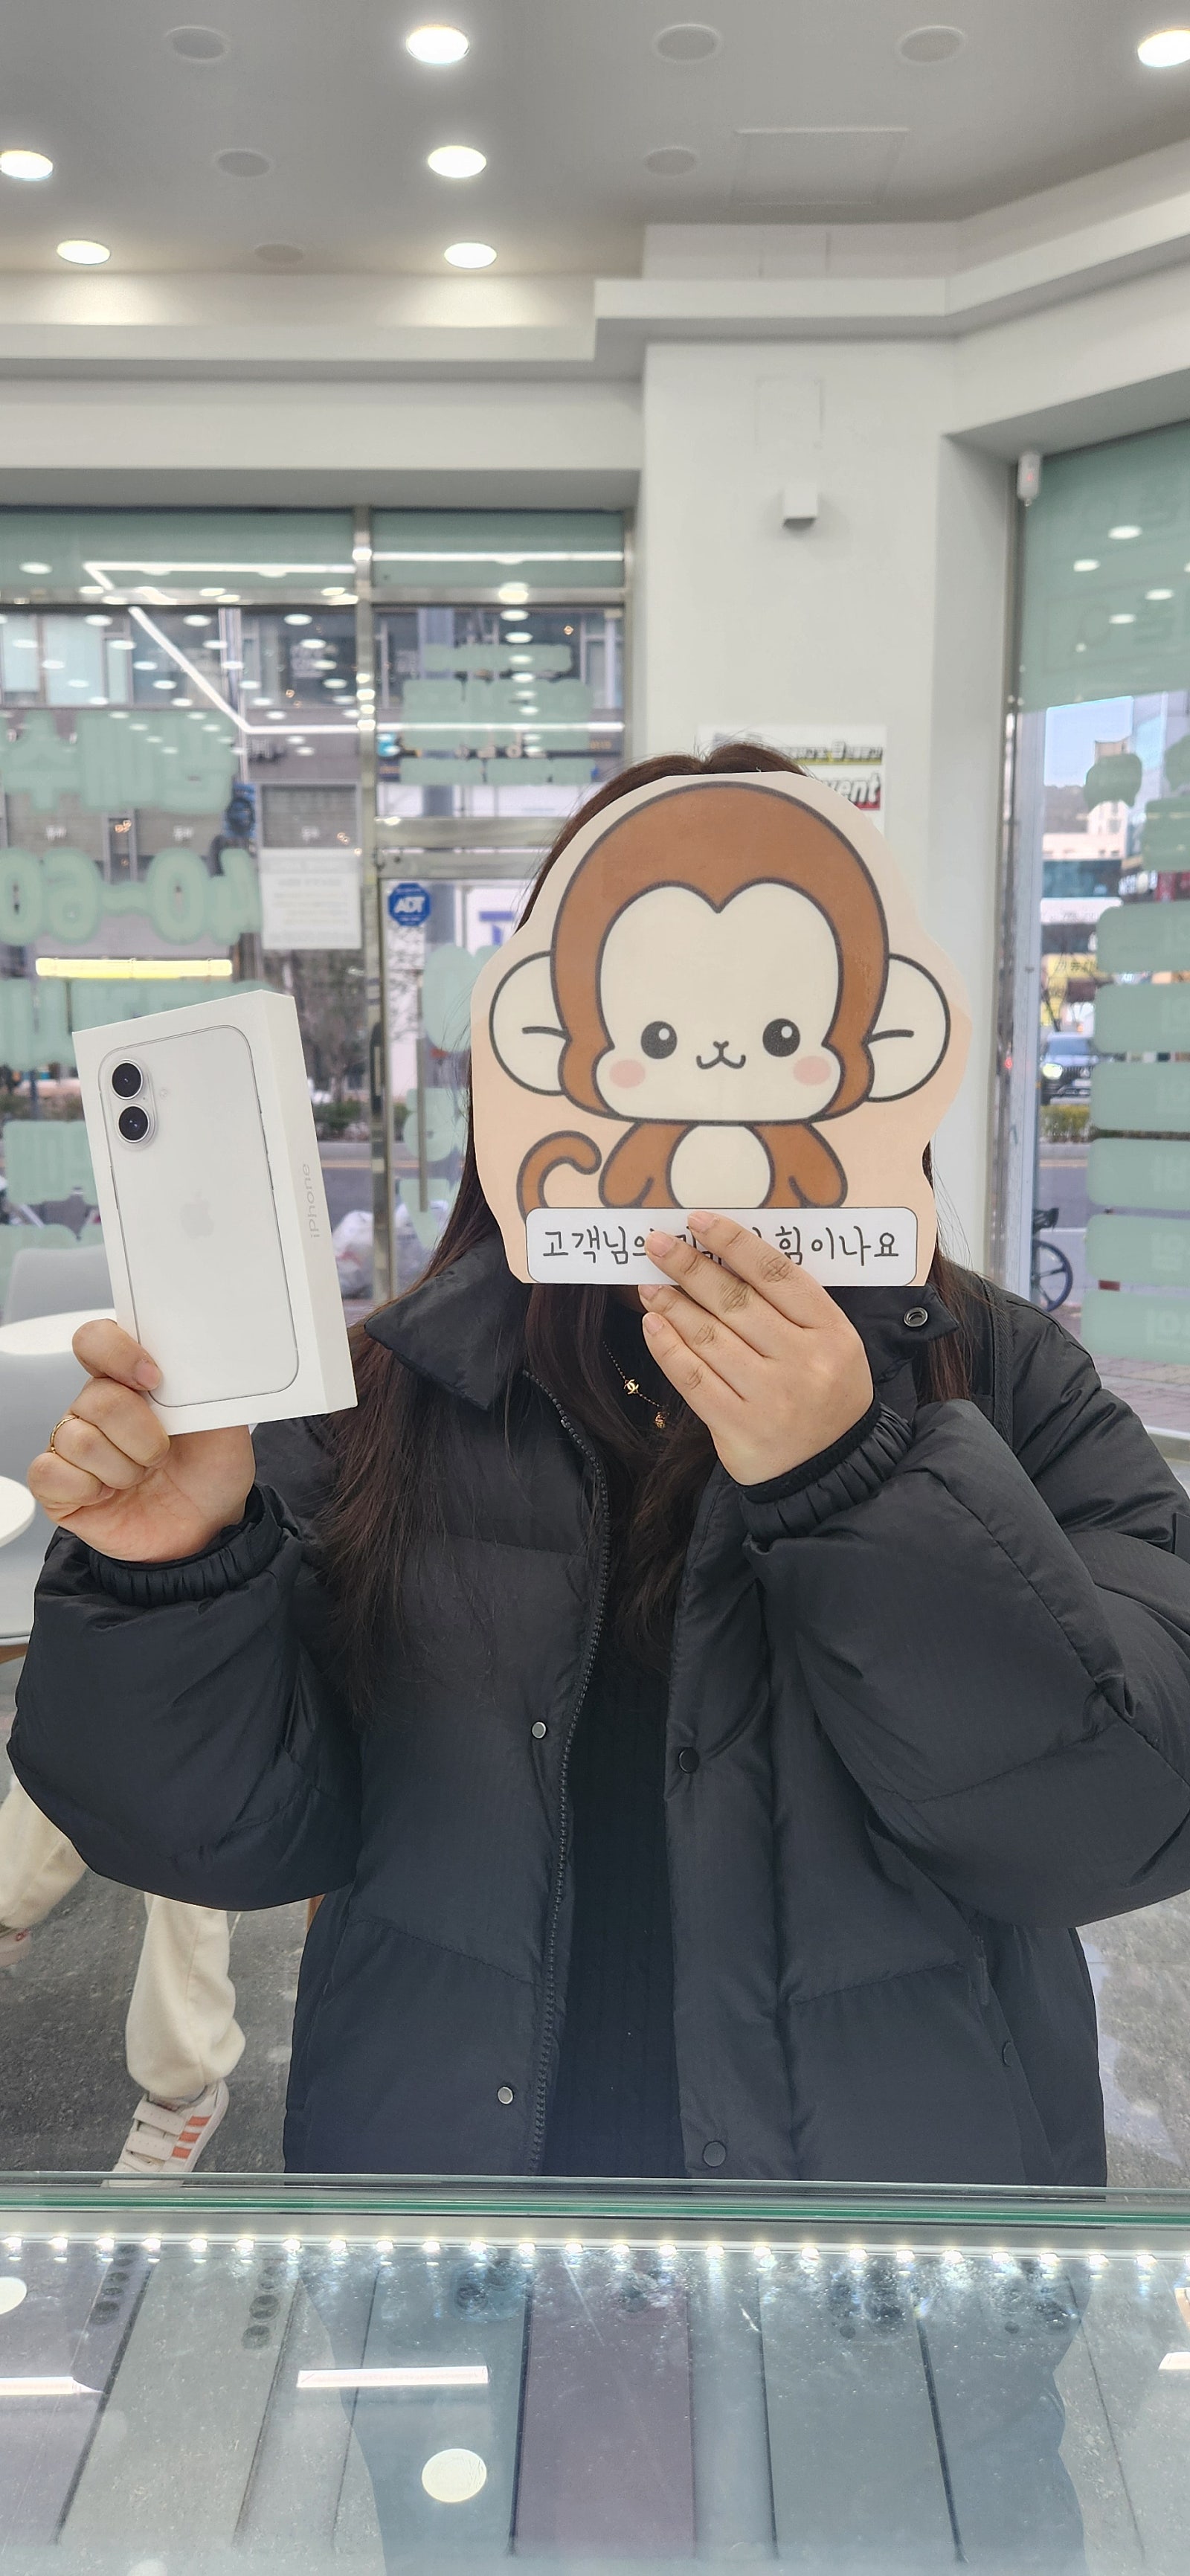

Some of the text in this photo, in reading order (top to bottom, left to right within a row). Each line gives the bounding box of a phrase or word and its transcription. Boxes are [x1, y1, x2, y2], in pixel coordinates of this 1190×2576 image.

[394, 896, 425, 913] ADT
[302, 1163, 321, 1238] iPhone
[775, 1225, 899, 1266] 힘이나요
